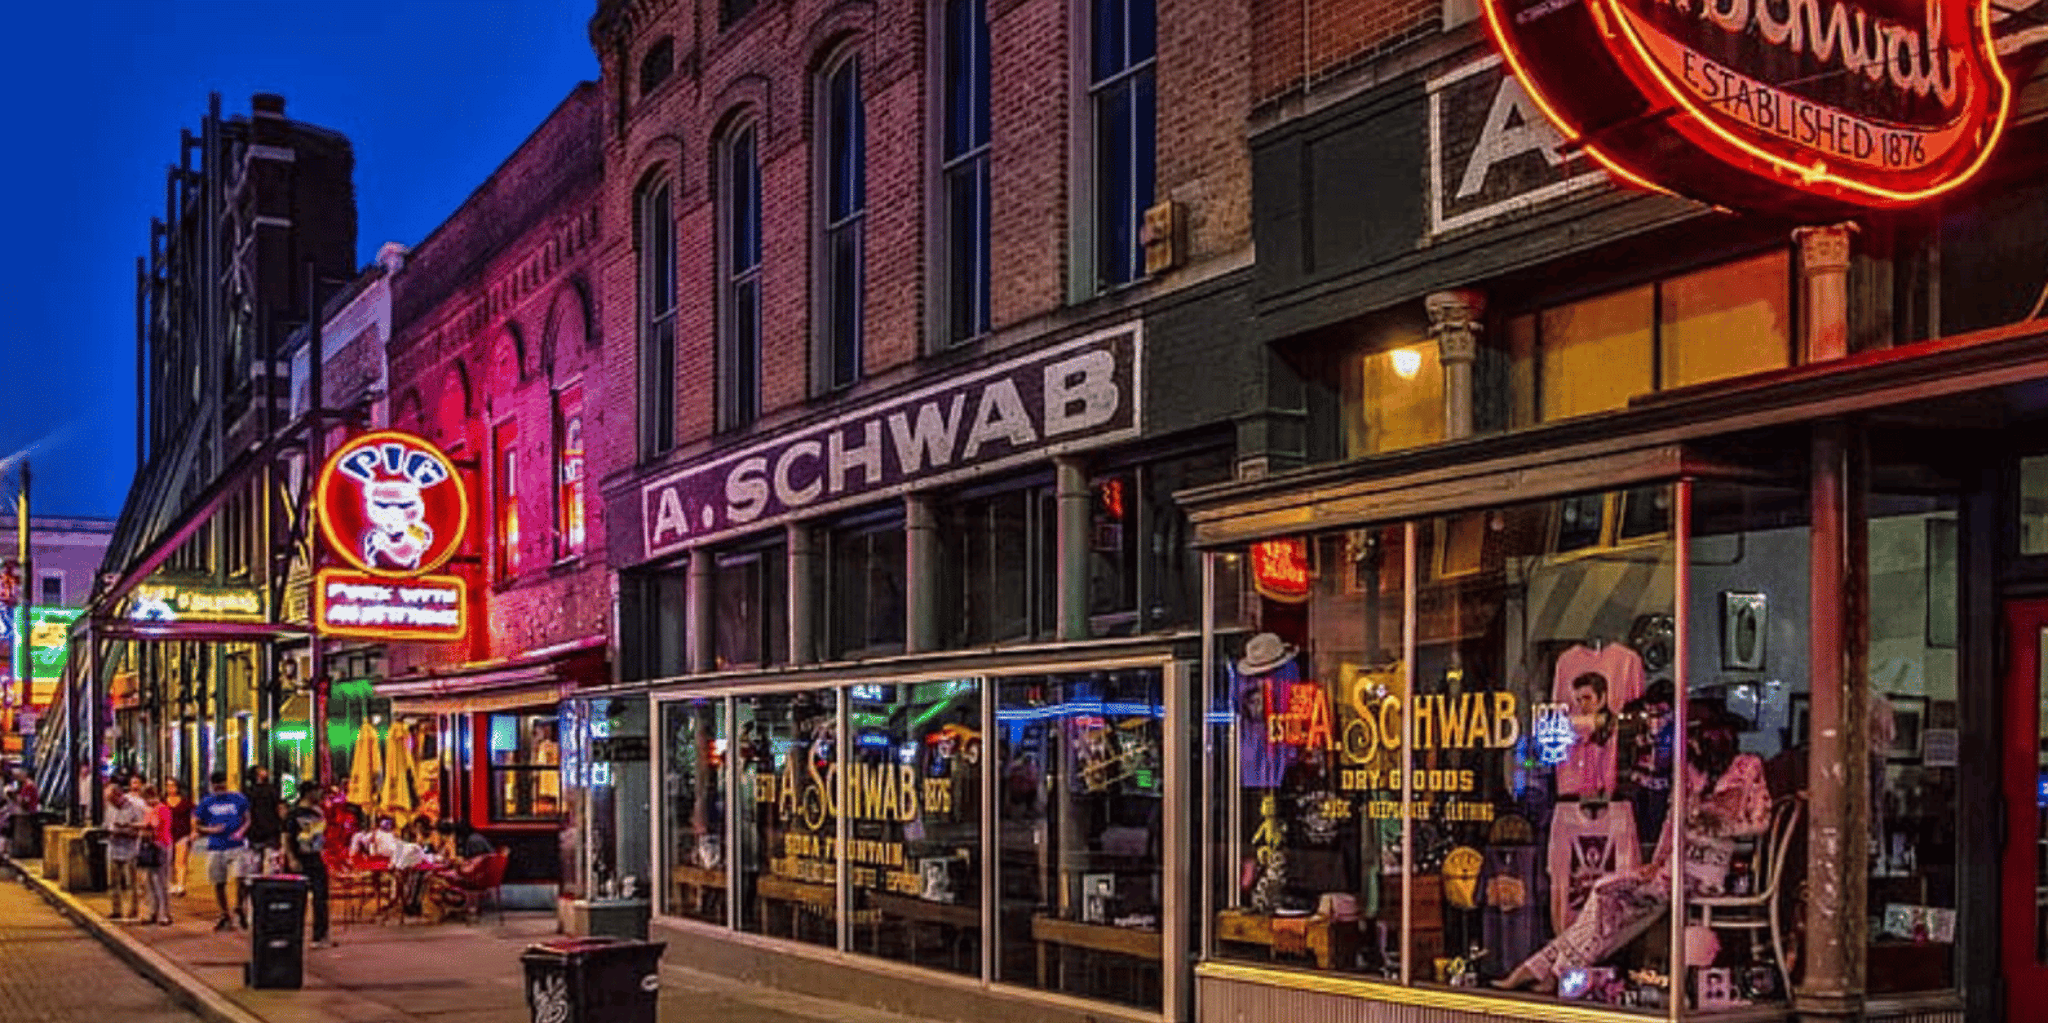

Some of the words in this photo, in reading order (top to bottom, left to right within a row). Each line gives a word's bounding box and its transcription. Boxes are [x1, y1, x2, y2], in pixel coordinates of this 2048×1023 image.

[1683, 51, 1873, 160] ESTABLISHED
[1880, 132, 1925, 167] 1876
[338, 443, 448, 488] PIG
[725, 349, 1119, 523] SCHWAB
[1343, 677, 1519, 764] SCHWAB
[803, 736, 918, 830] SCHWAB
[1341, 769, 1379, 790] DRY
[1389, 769, 1474, 792] GOODS
[826, 837, 903, 866] FUNTAIN
